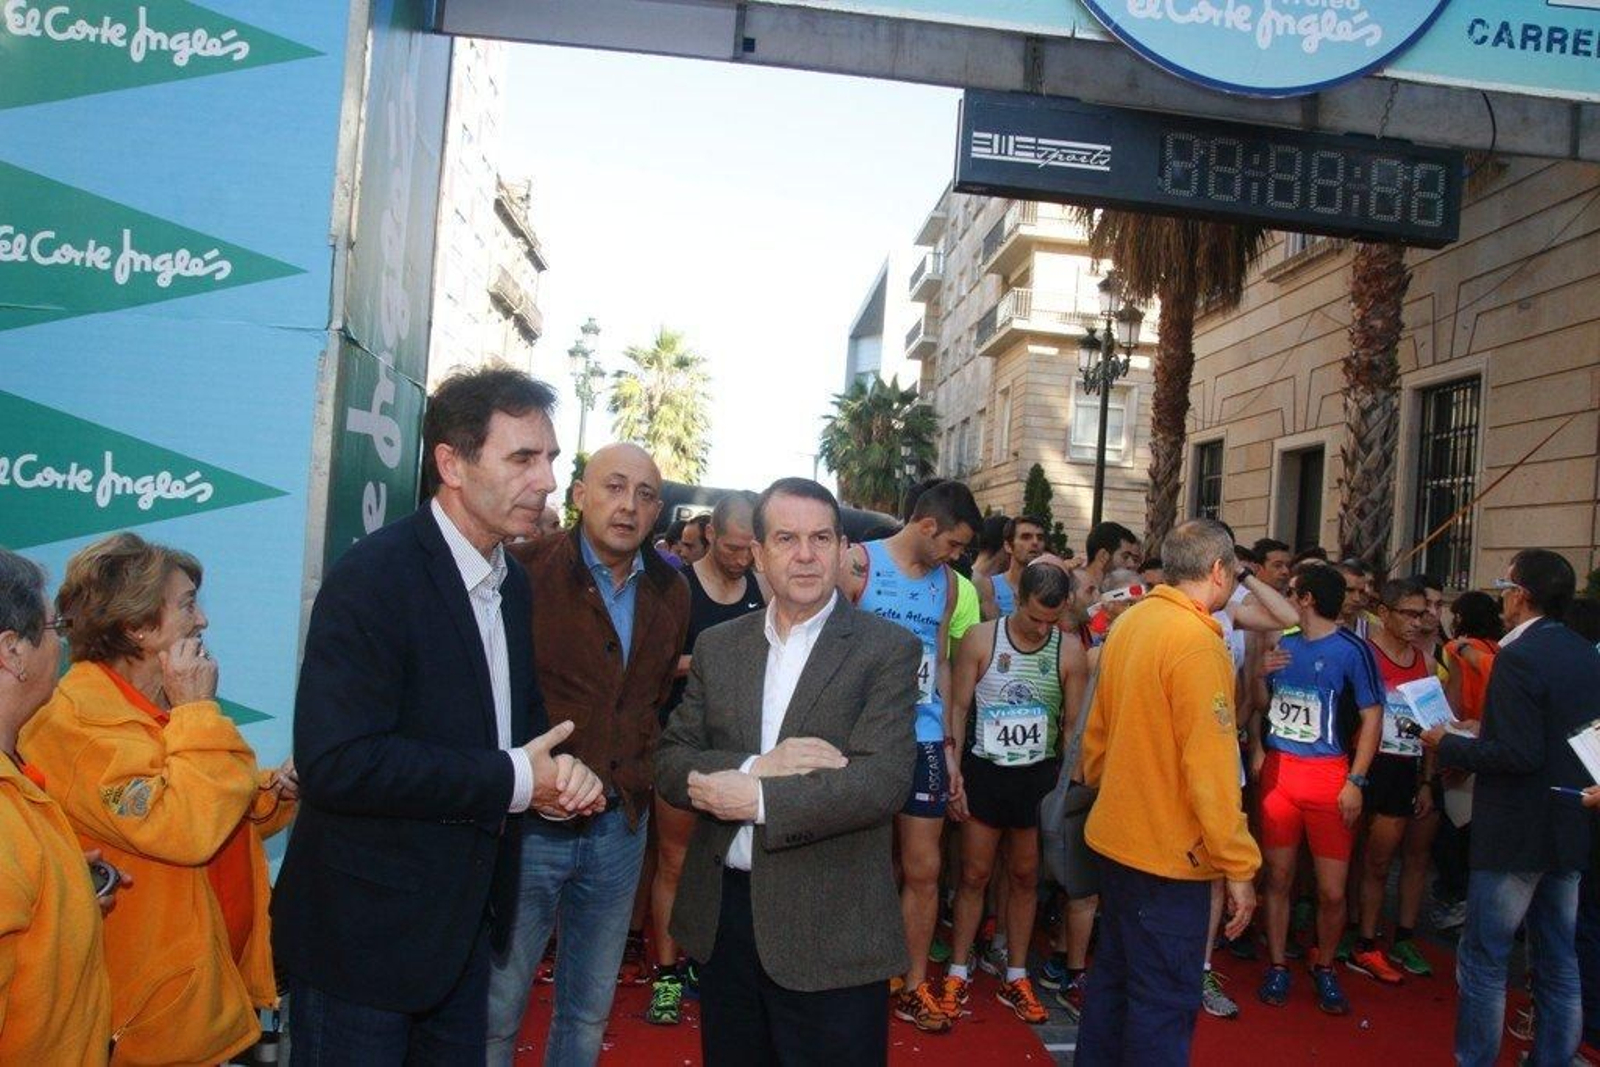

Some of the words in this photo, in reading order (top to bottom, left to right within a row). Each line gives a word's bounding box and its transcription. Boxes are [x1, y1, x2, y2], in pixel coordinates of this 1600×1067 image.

[4, 0, 42, 36] El
[44, 5, 127, 47] Corte
[131, 6, 250, 67] Inglés
[1467, 17, 1600, 59] CARRE
[0, 225, 28, 262] El
[30, 230, 112, 270] Corte
[114, 228, 232, 287] Inglés
[12, 454, 94, 493] Corte
[96, 451, 214, 510] Inglés
[997, 723, 1041, 747] 404
[1280, 702, 1312, 726] 971
